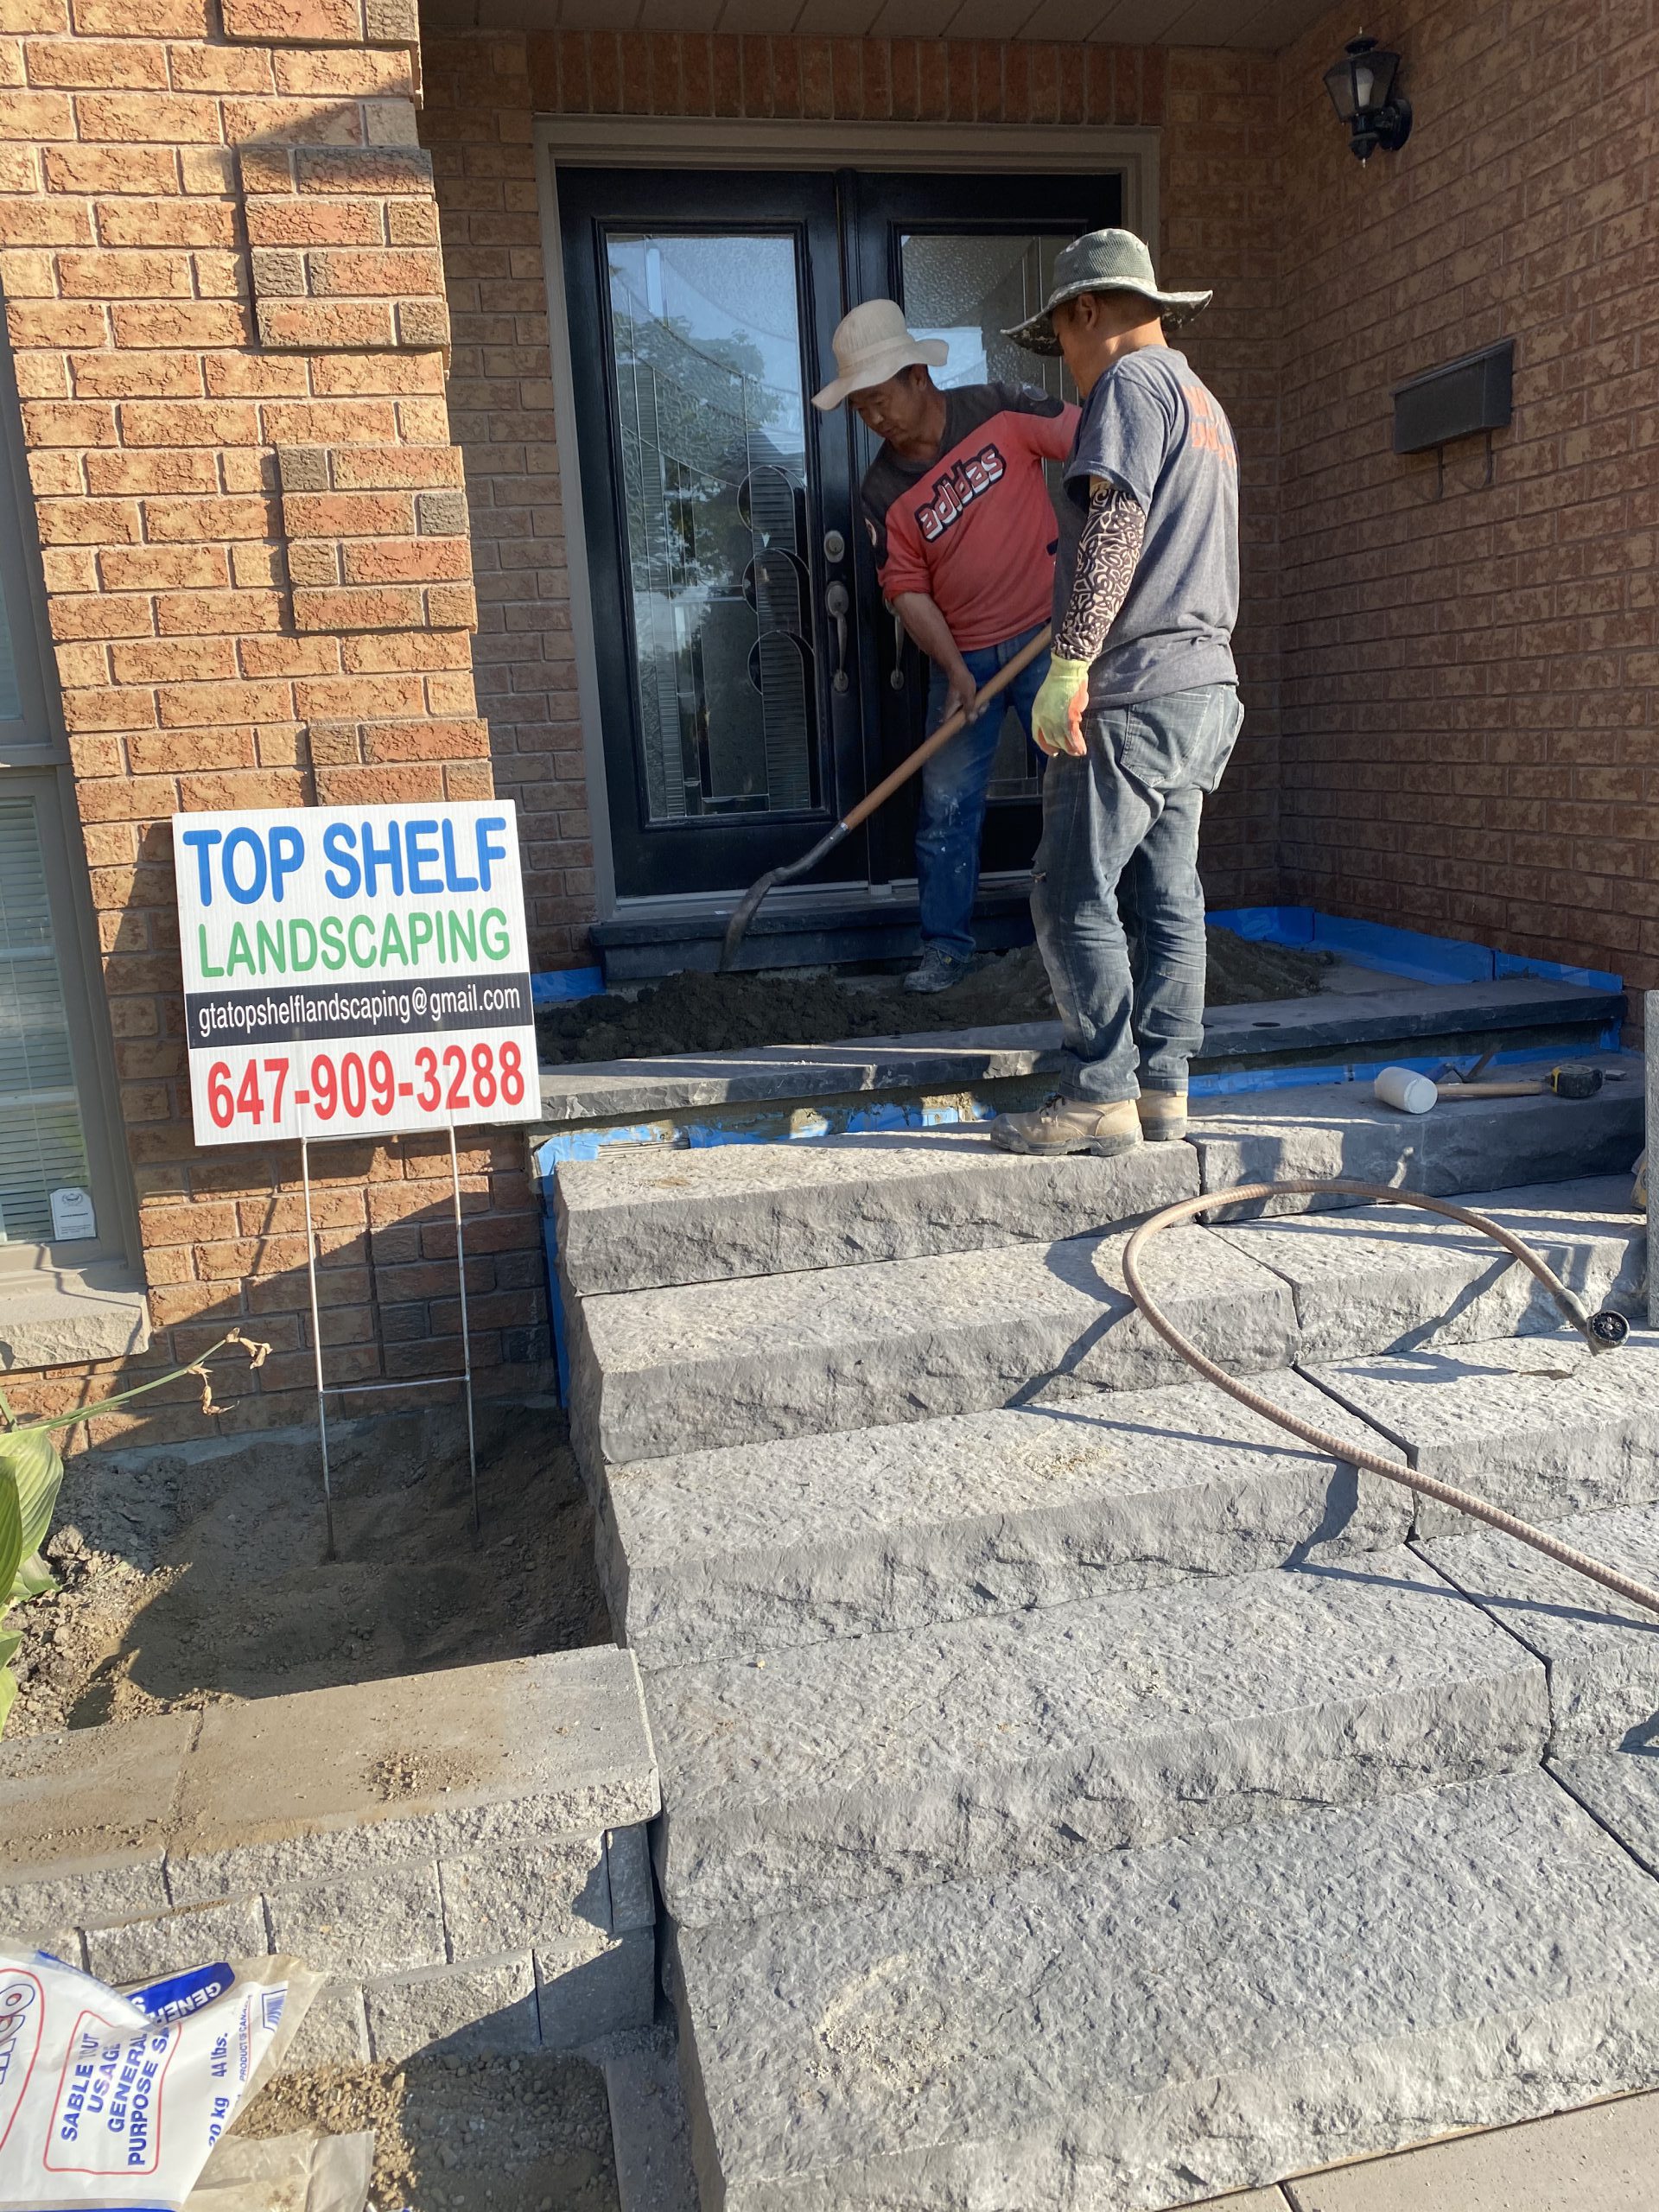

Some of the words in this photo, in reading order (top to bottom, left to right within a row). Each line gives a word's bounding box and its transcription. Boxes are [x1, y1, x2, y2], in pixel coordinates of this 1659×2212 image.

[916, 444, 1006, 542] adidas
[182, 825, 305, 906] TOP
[323, 817, 507, 899] SHELF
[198, 907, 512, 977] LANDSCAPING
[198, 985, 520, 1037] gtatopshelflandscaping@gmail.com
[207, 1040, 525, 1128] 647-909-3288
[86, 2043, 120, 2113] USAGE
[107, 2033, 147, 2133] GENERAL
[211, 2062, 228, 2077] 44
[238, 2040, 248, 2082] PRODUCT
[60, 2064, 94, 2142] SABLE
[127, 2060, 159, 2165] PURPOSE
[211, 2097, 230, 2119] kg
